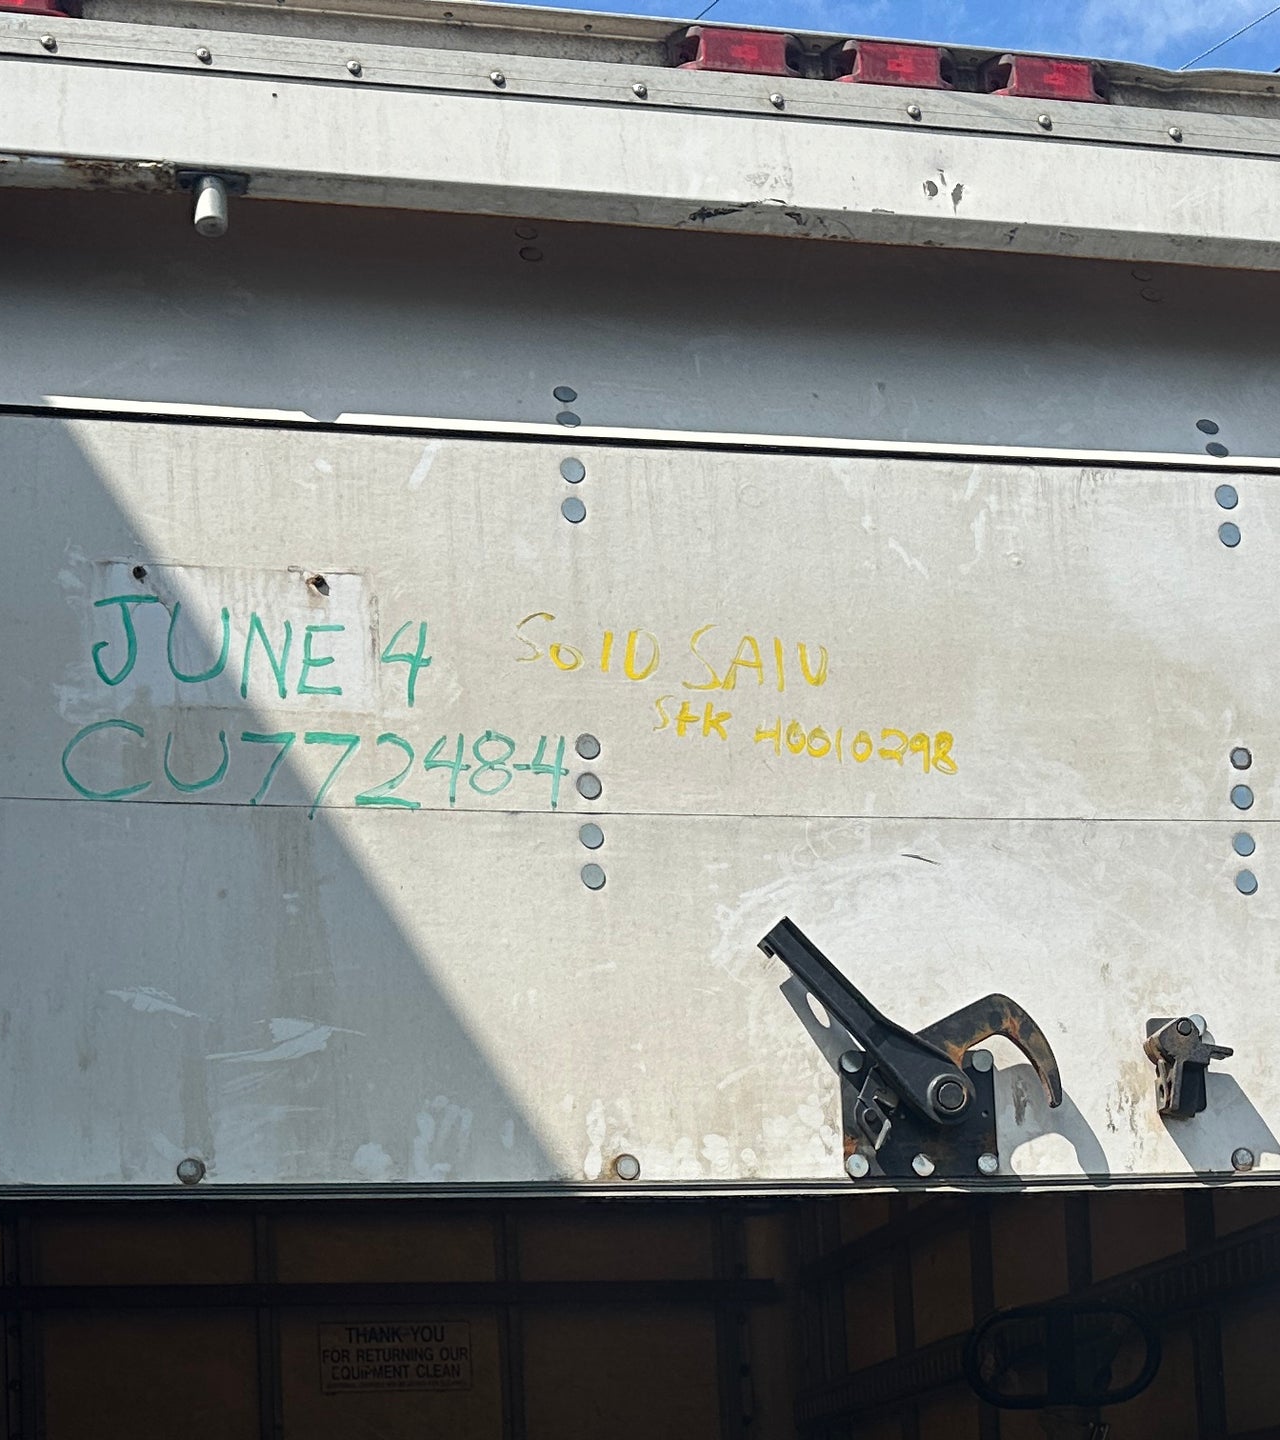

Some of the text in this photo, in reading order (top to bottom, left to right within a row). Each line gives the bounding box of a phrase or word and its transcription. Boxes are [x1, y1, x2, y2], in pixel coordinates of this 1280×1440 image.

[91, 594, 433, 708] JUNE 4
[322, 1346, 469, 1364] FOR RETURNING OUR
[331, 1363, 461, 1381] EQUIPMENT CLEAN
